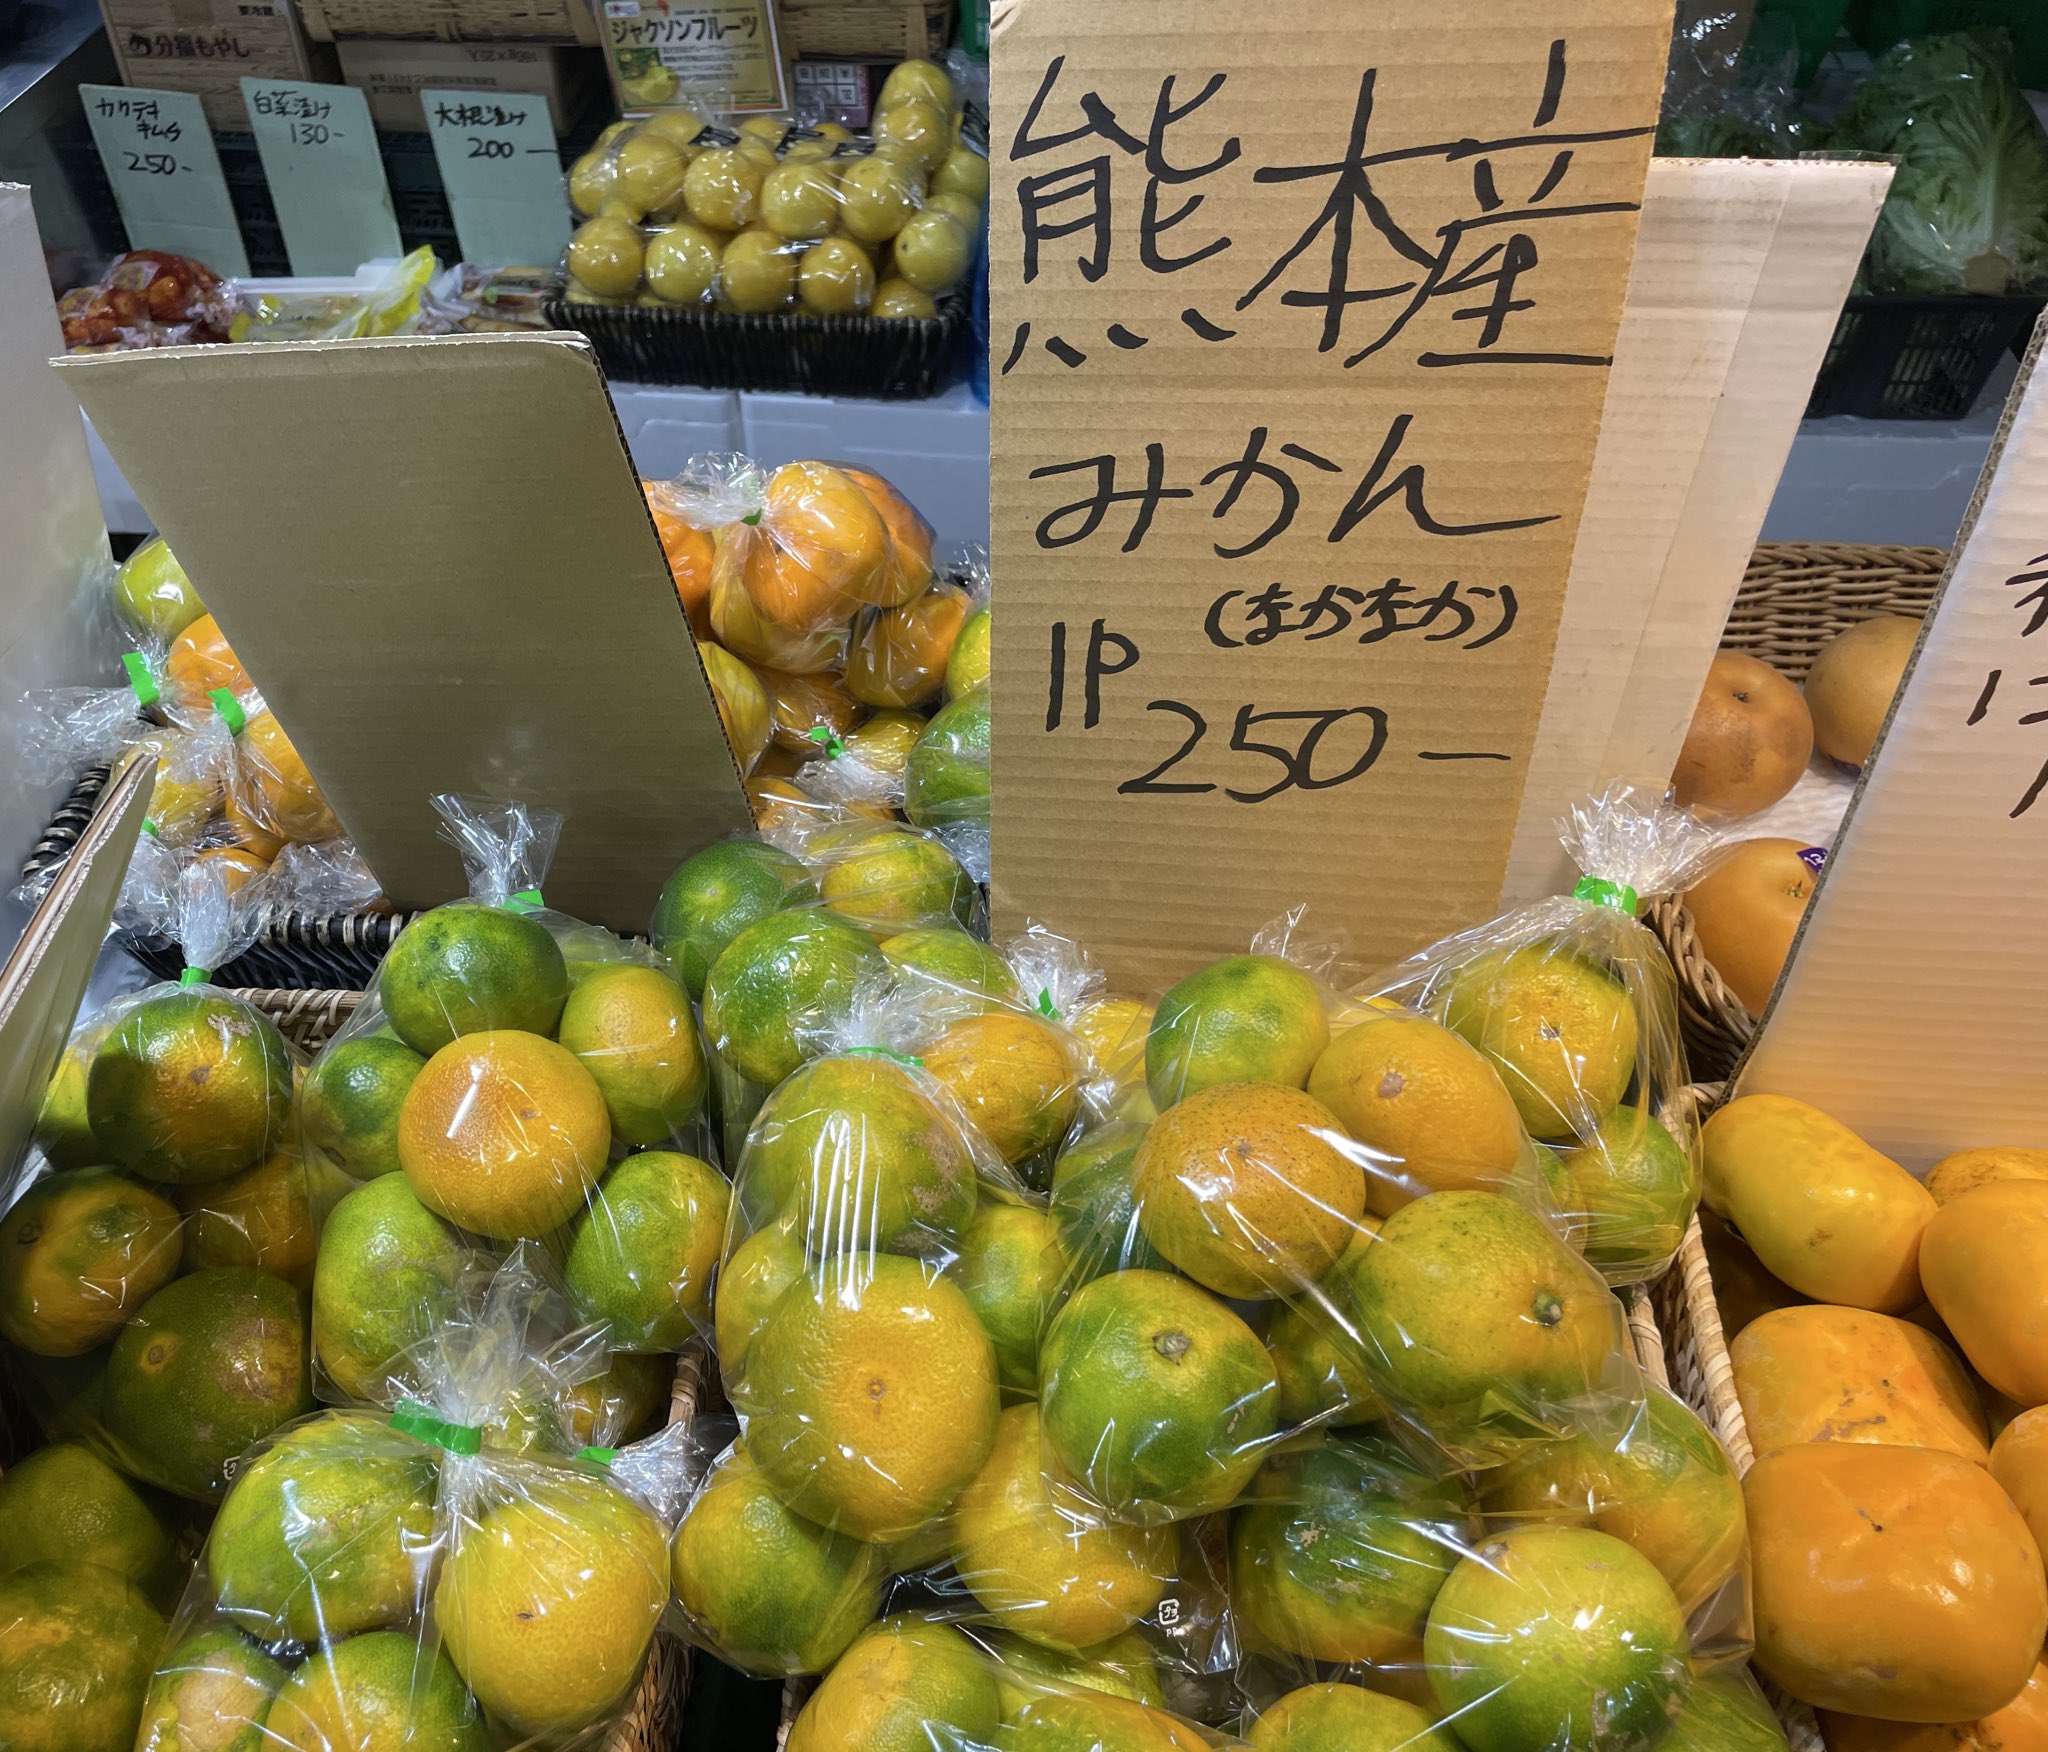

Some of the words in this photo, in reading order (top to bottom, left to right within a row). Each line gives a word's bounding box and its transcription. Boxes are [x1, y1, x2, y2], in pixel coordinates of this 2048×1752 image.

[611, 16, 758, 44] ジャクソンフルーツ
[96, 97, 160, 121] カクテキ
[136, 118, 184, 142] キムチ
[1002, 40, 1659, 375] 熊本産
[1029, 415, 1561, 558] みかん
